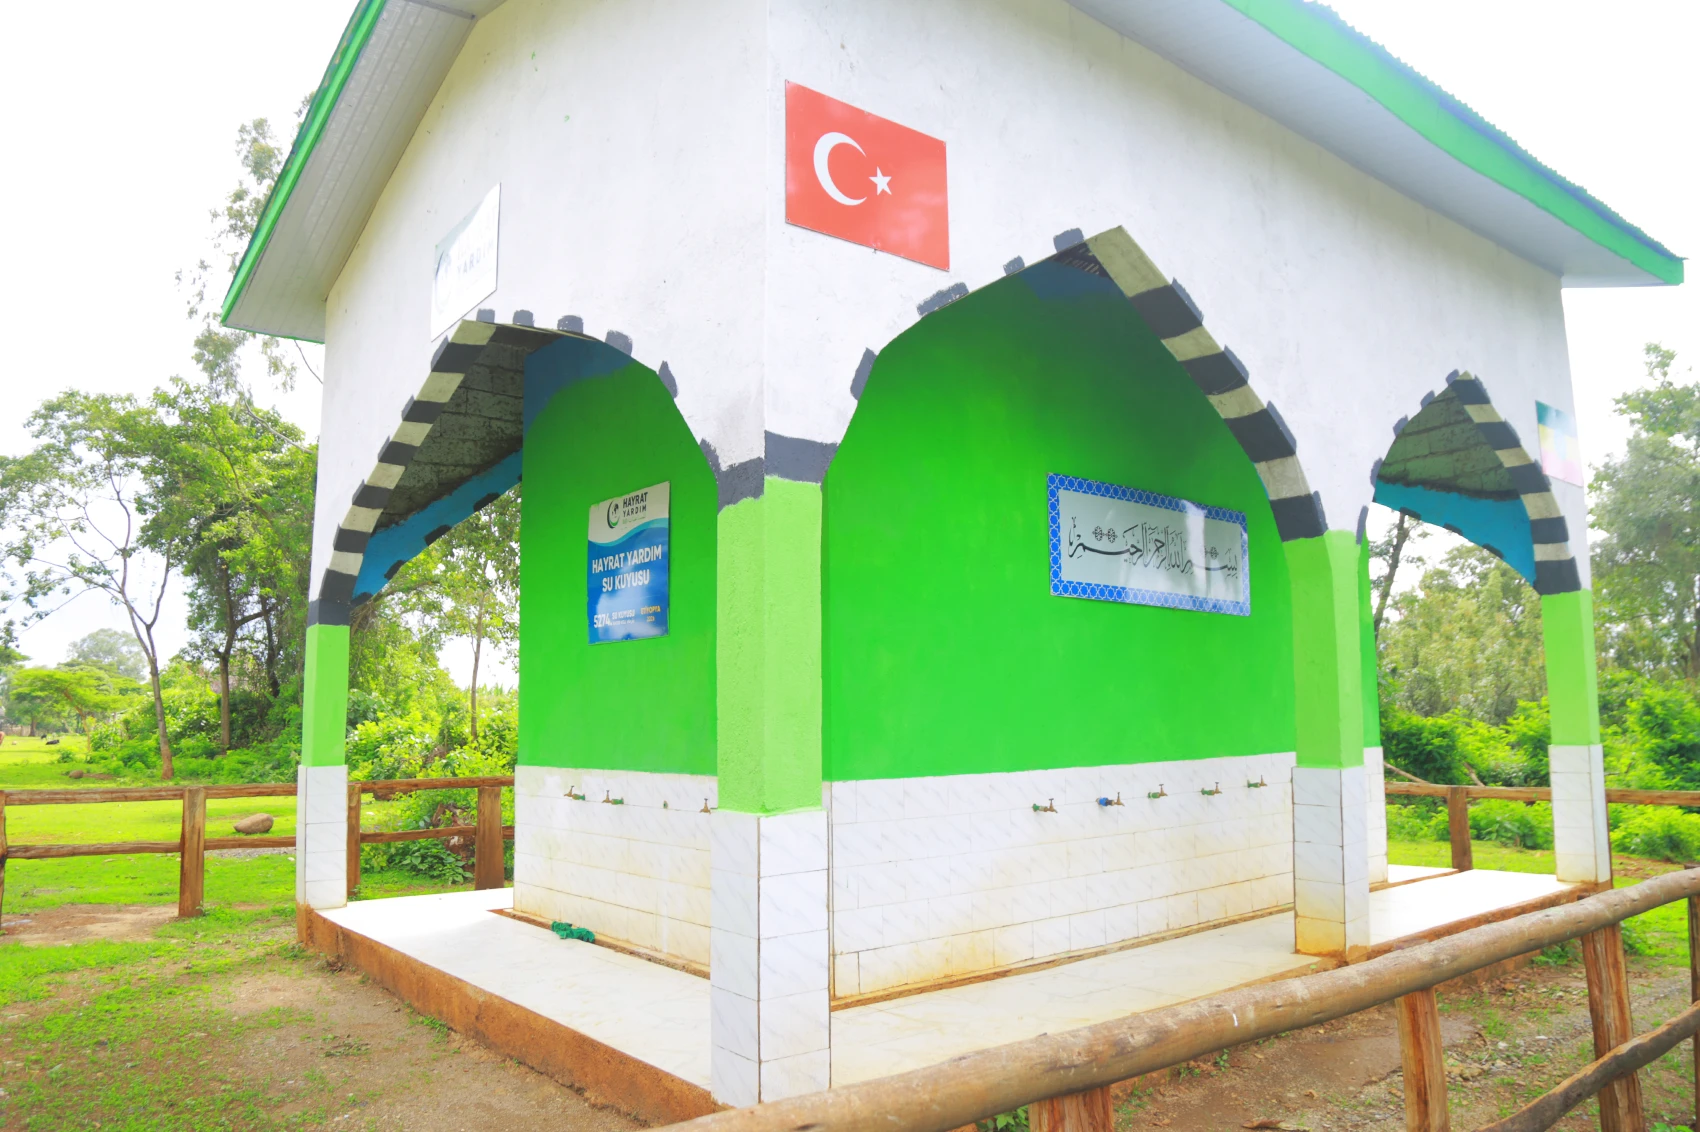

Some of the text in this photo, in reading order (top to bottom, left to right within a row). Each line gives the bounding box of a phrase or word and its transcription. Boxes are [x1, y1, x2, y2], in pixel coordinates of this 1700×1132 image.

[623, 492, 648, 508] HAYRAT
[623, 504, 647, 517] YARDIM
[592, 544, 662, 574] HAYRAT YARDIM
[602, 569, 650, 592] SU KUYUSU
